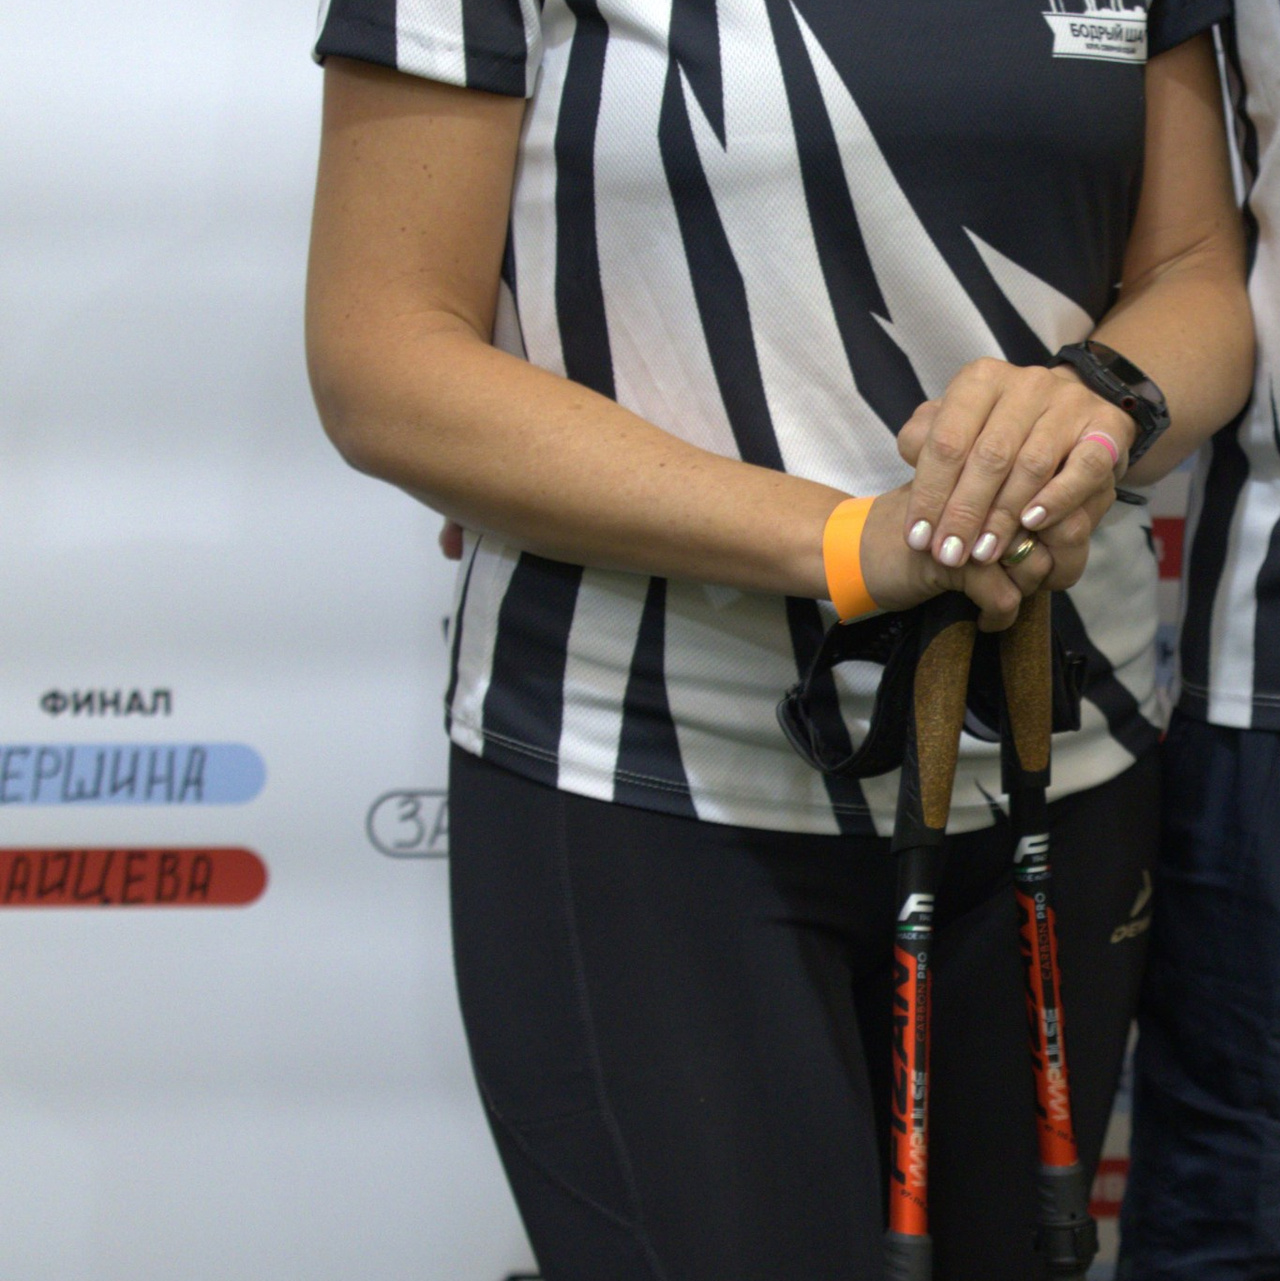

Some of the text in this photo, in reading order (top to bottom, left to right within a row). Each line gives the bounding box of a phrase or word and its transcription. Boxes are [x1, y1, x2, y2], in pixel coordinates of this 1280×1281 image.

[1070, 23, 1123, 42] БОДРЫЙ
[40, 687, 174, 717] ФИНАЛ
[1034, 891, 1051, 981] CARBON PRO
[916, 951, 928, 1043] CARBON PRO
